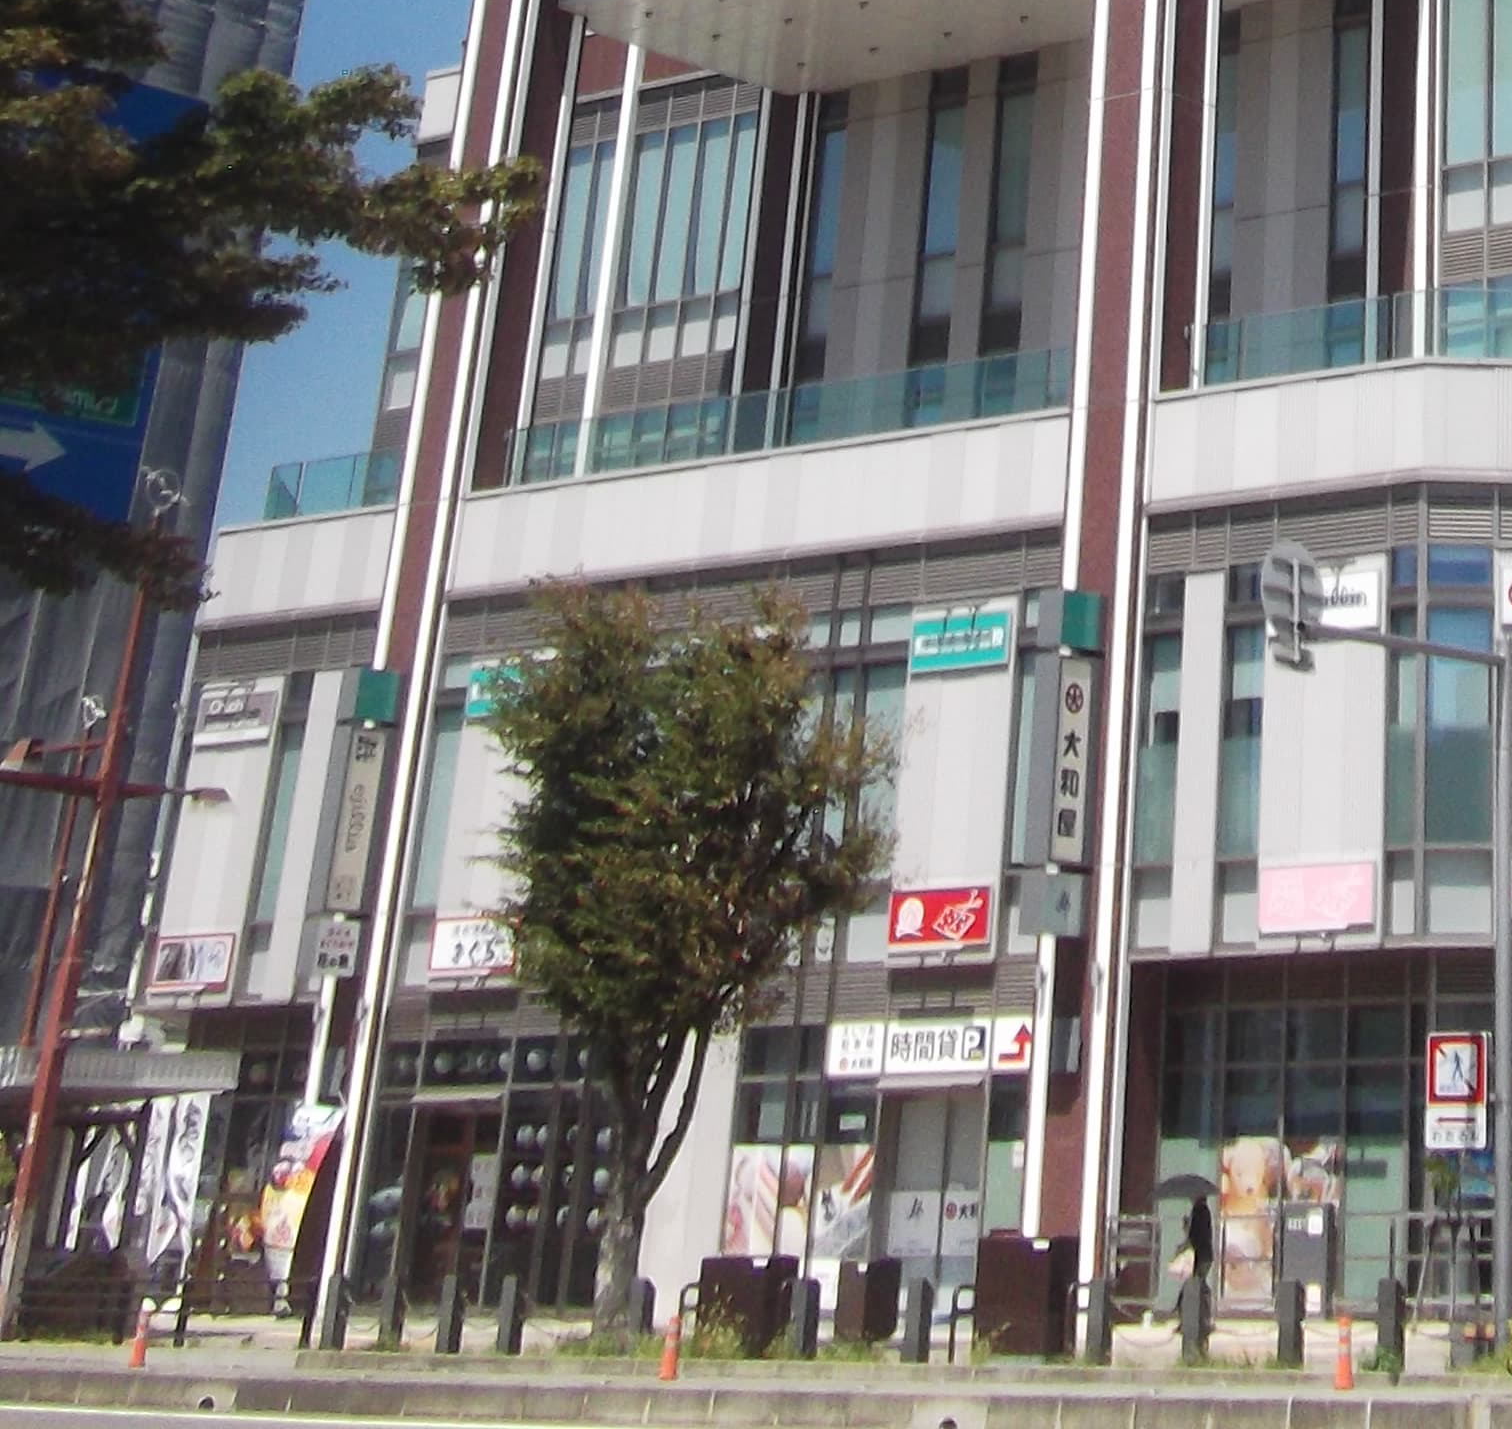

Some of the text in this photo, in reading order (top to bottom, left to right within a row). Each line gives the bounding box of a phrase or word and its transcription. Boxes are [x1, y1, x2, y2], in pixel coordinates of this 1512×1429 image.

[1056, 729, 1082, 838] 大和屋
[890, 1027, 959, 1063] 時間貸
[962, 1027, 984, 1060] P
